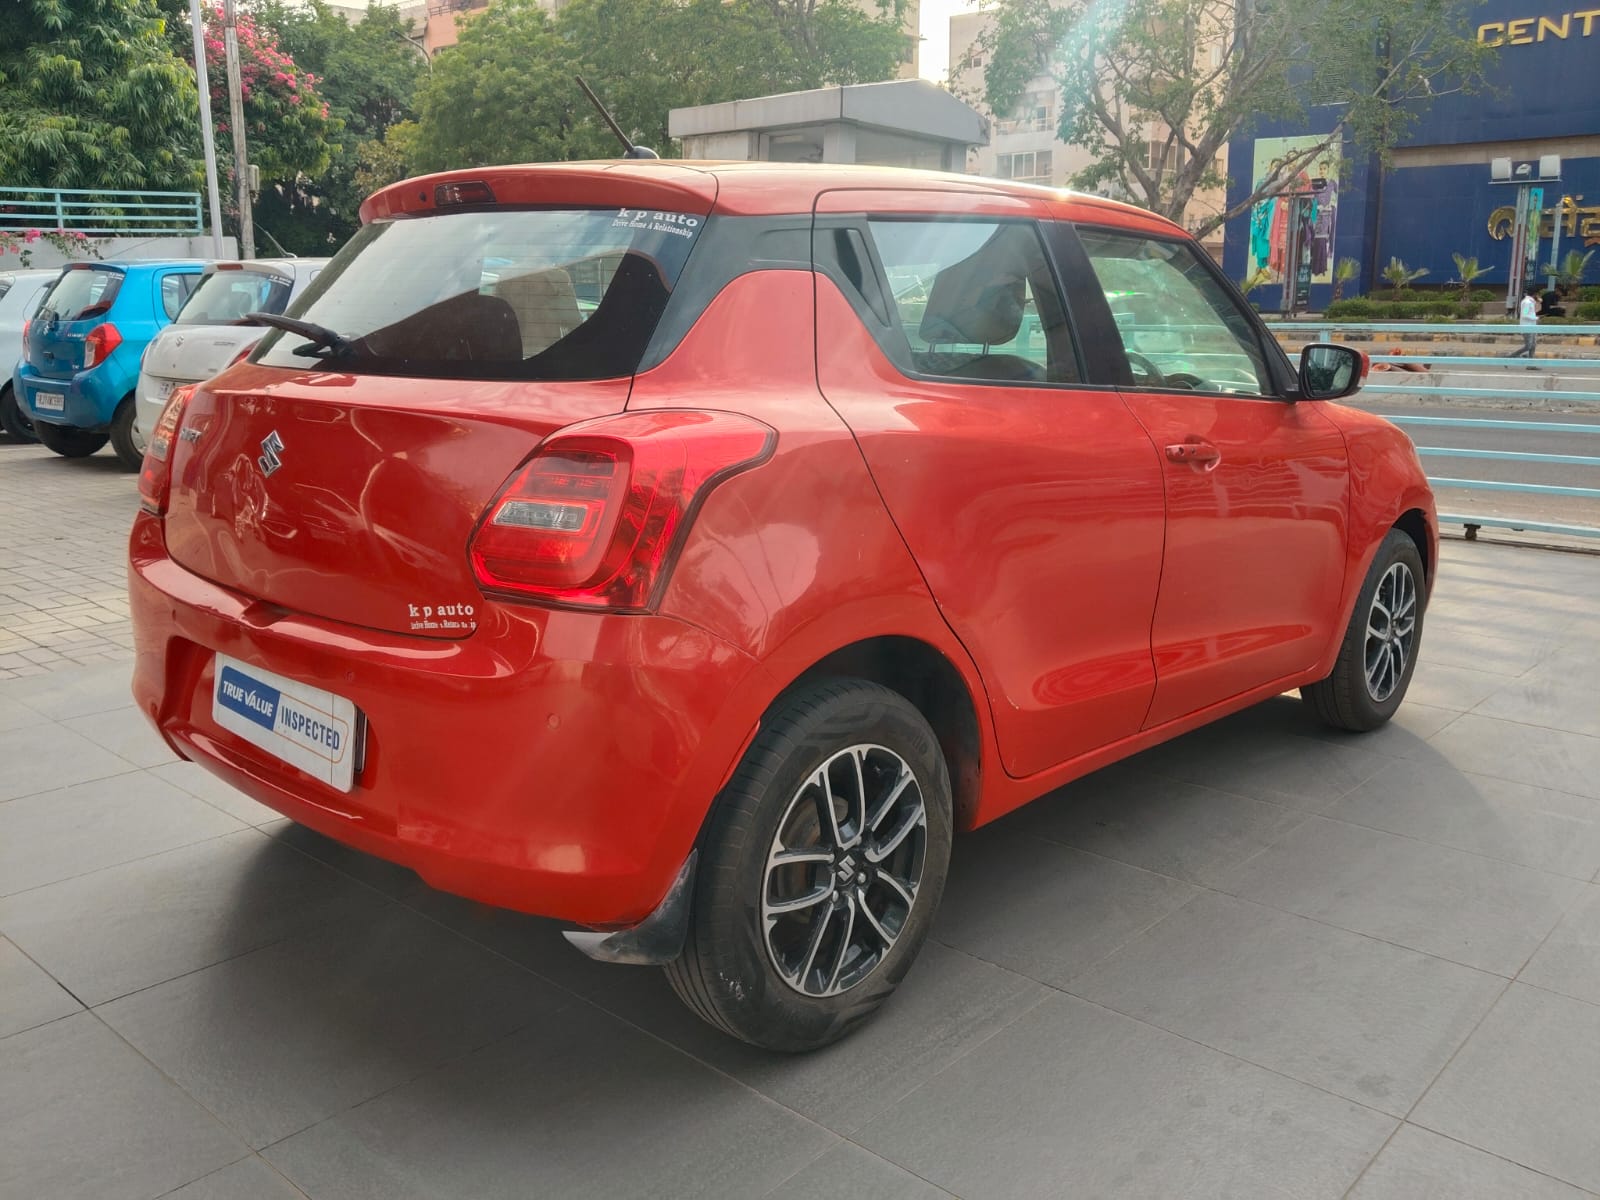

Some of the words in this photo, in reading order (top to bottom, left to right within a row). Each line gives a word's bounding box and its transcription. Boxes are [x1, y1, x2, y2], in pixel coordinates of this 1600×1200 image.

[1477, 9, 1600, 48] CENT
[617, 208, 630, 218] k
[634, 210, 647, 221] p
[653, 211, 698, 227] auto
[653, 223, 693, 238] Relationship
[408, 603, 420, 617] k
[423, 606, 433, 618] p
[437, 602, 474, 616] auto
[223, 680, 245, 702] TRUE
[244, 689, 274, 718] VALUE
[281, 705, 340, 751] INSPECTED
